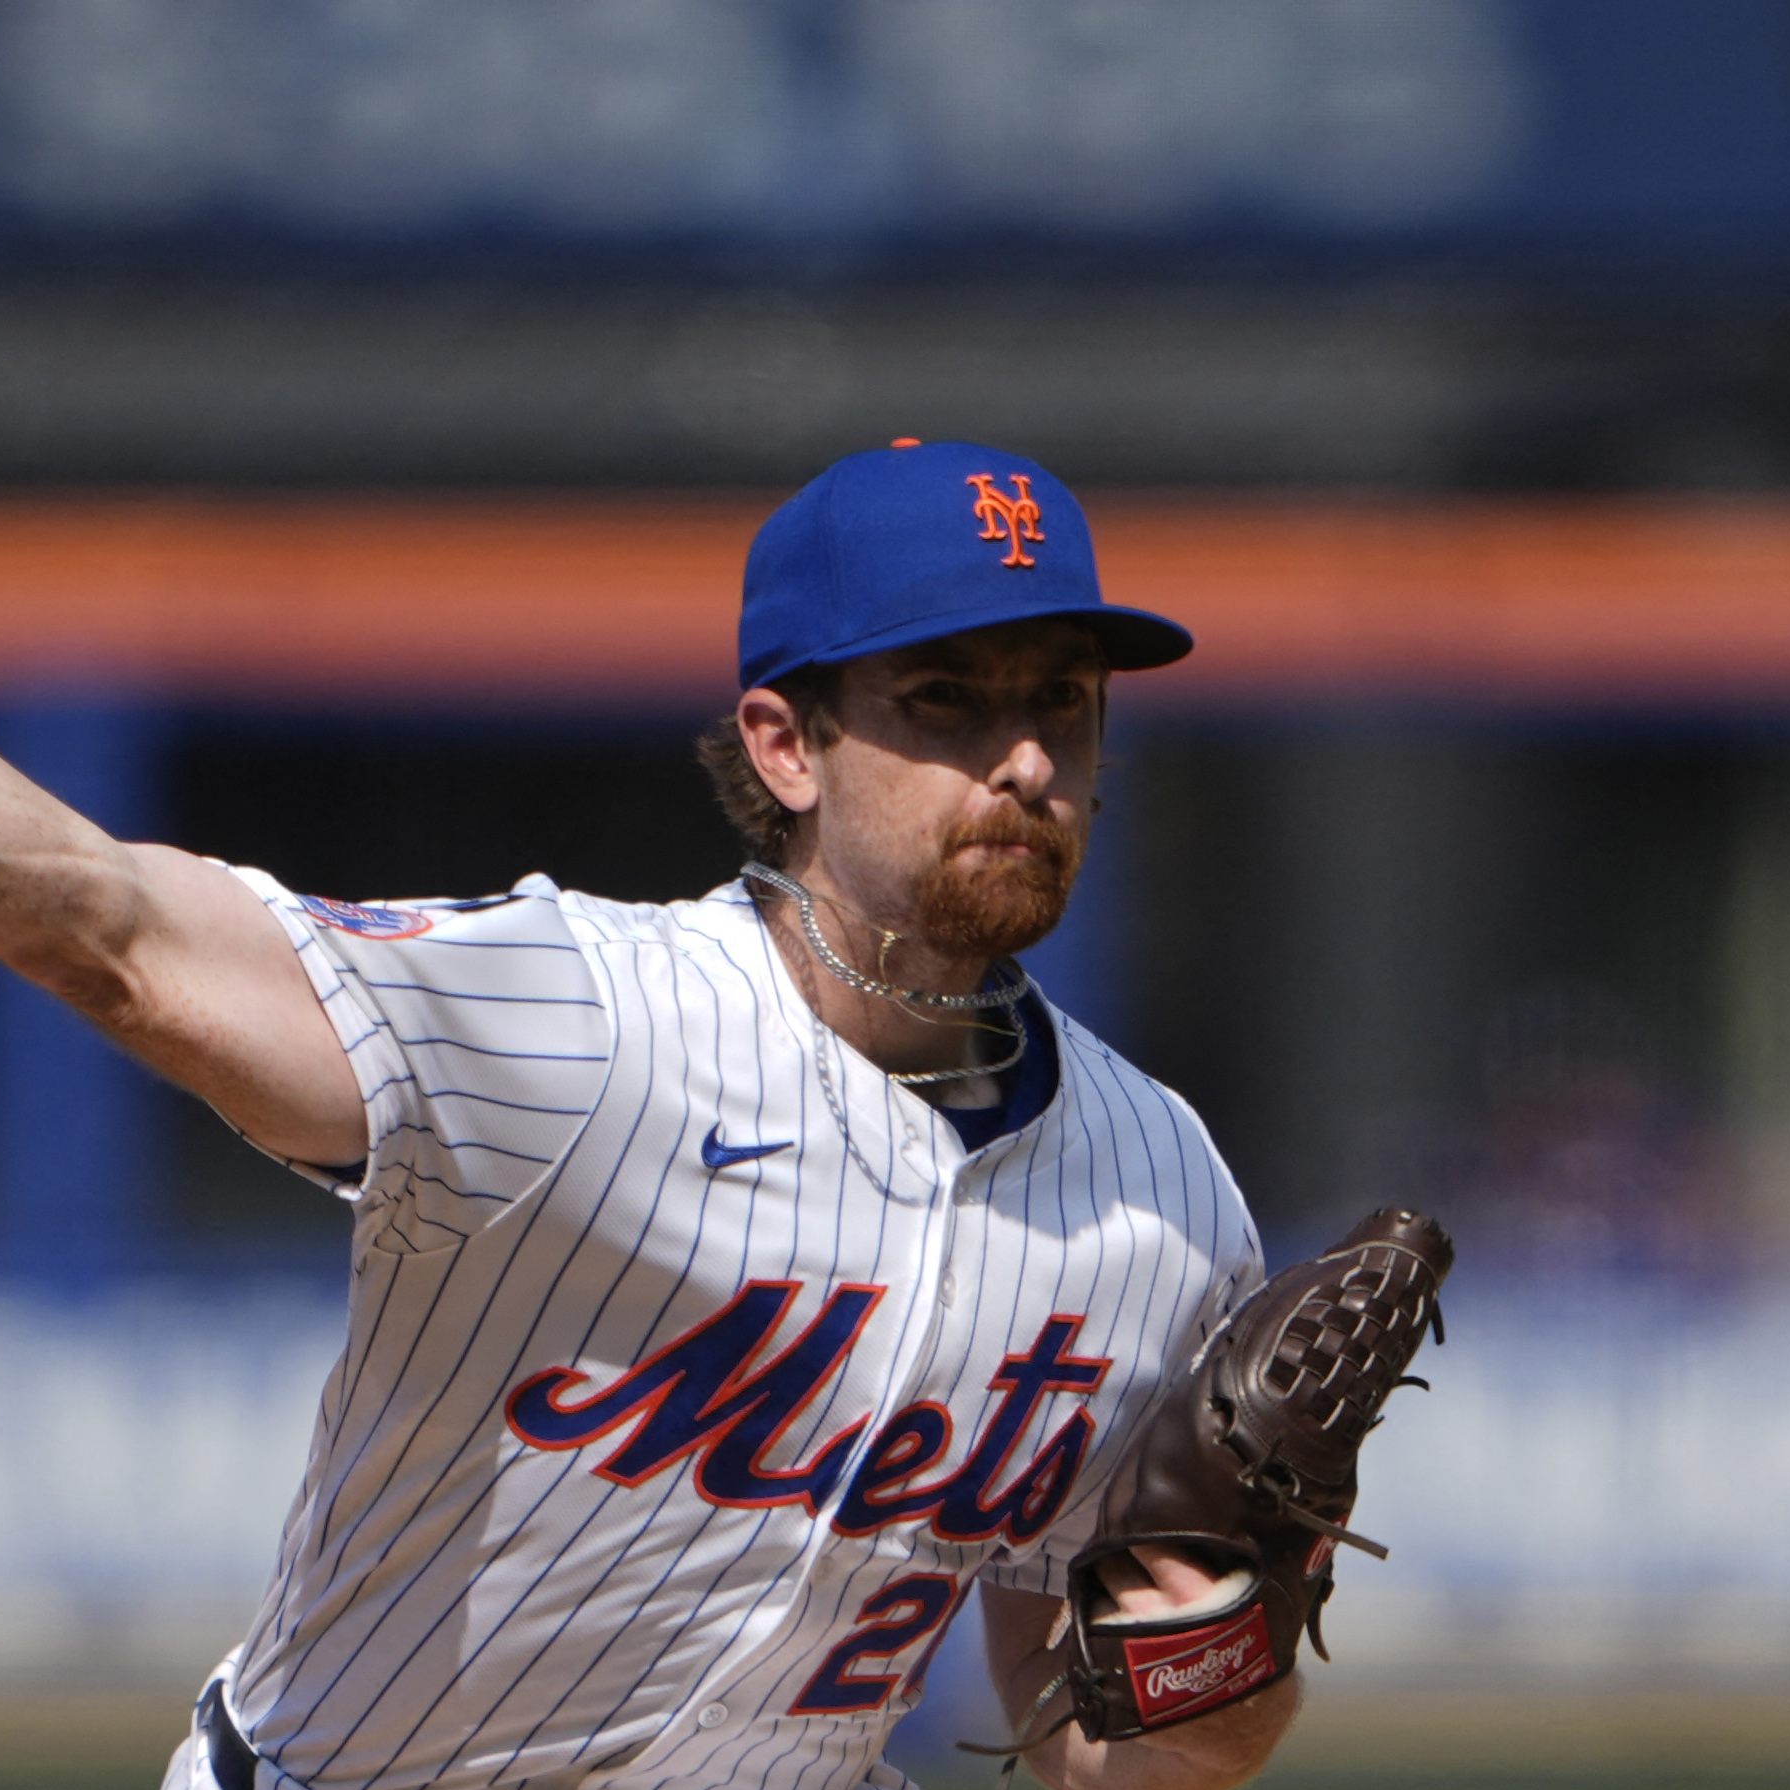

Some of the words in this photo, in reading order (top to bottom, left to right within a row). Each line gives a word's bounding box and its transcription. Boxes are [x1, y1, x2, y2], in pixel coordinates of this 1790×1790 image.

[966, 472, 1045, 568] NY
[504, 1279, 1113, 1547] Mets
[785, 1570, 975, 1716] 2
[1147, 1633, 1256, 1698] Rawlings
